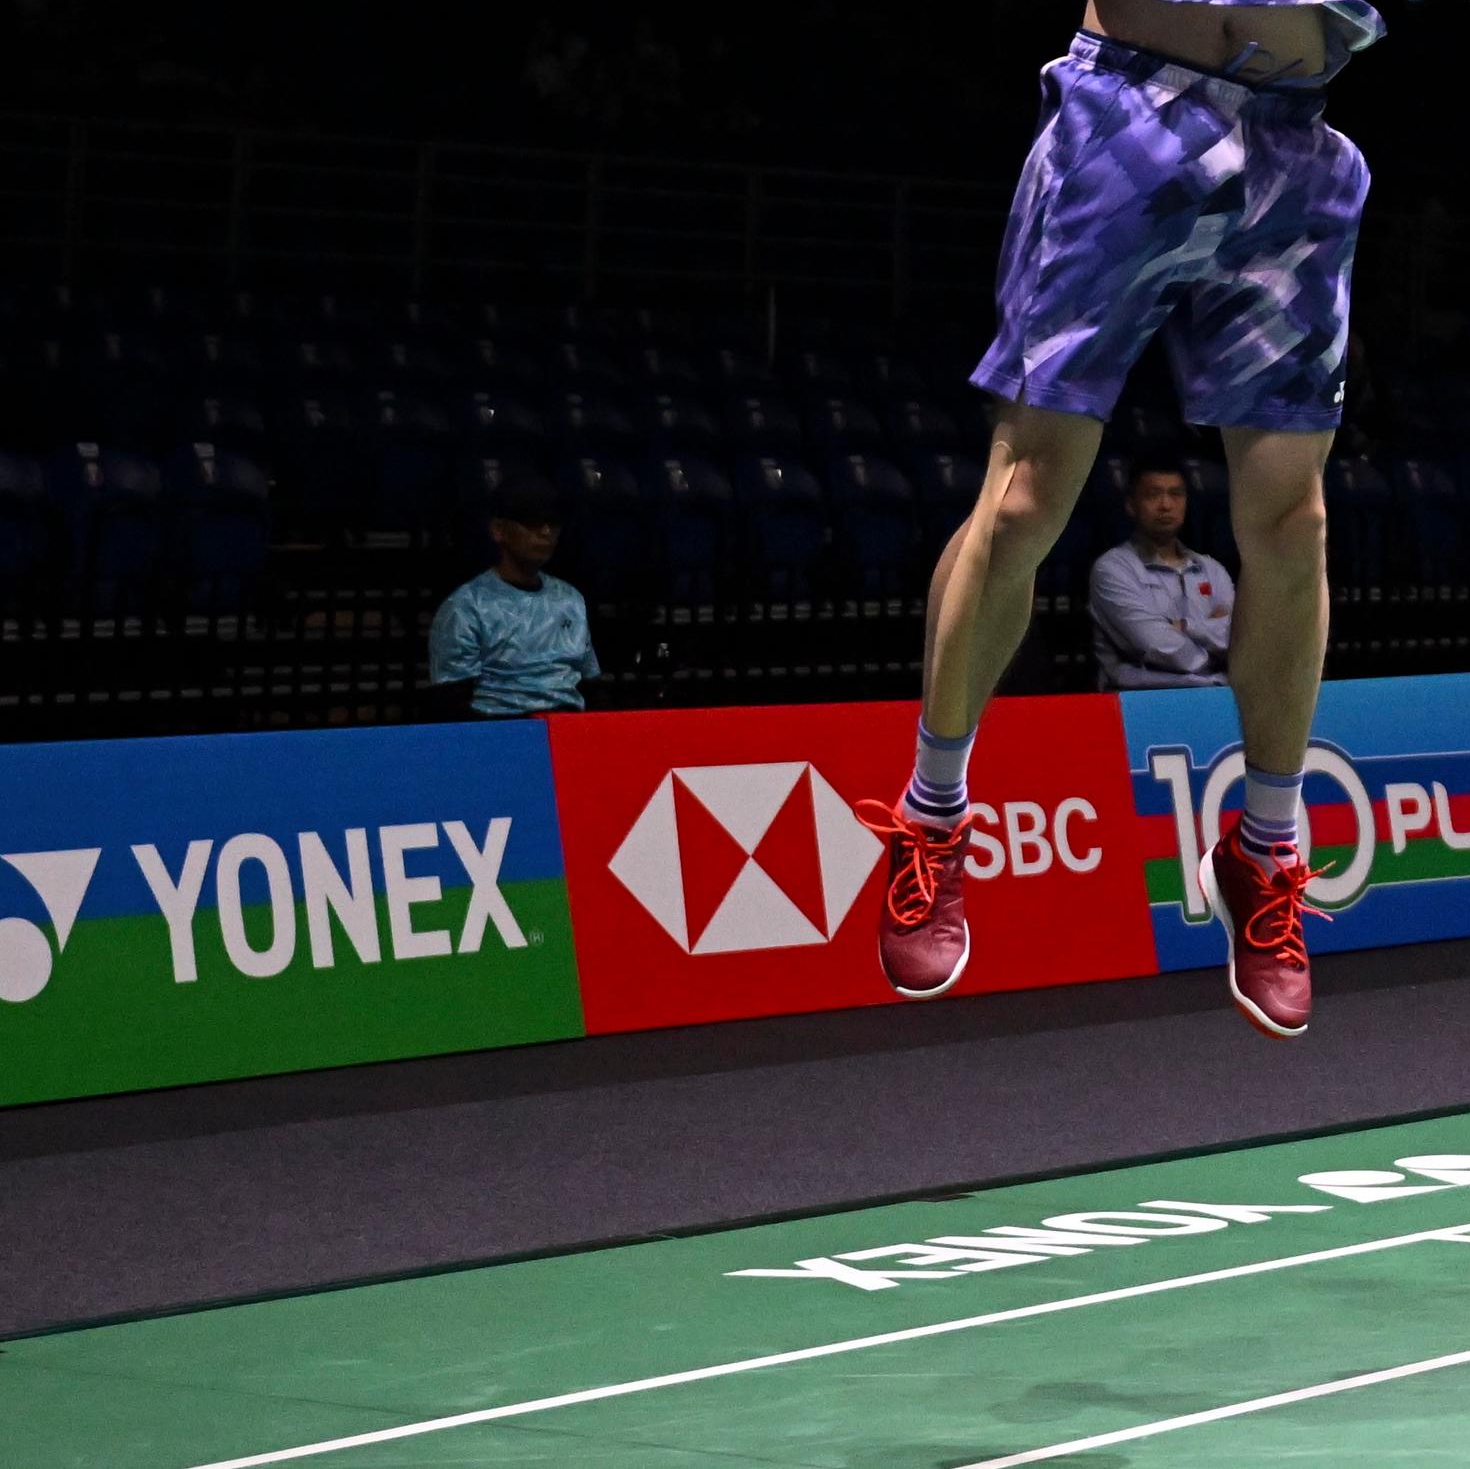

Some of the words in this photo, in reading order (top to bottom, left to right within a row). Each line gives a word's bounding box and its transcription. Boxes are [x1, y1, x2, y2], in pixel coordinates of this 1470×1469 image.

[963, 796, 1103, 880] SBC
[130, 817, 528, 983] YONEX
[722, 1199, 1335, 1292] YONEX
